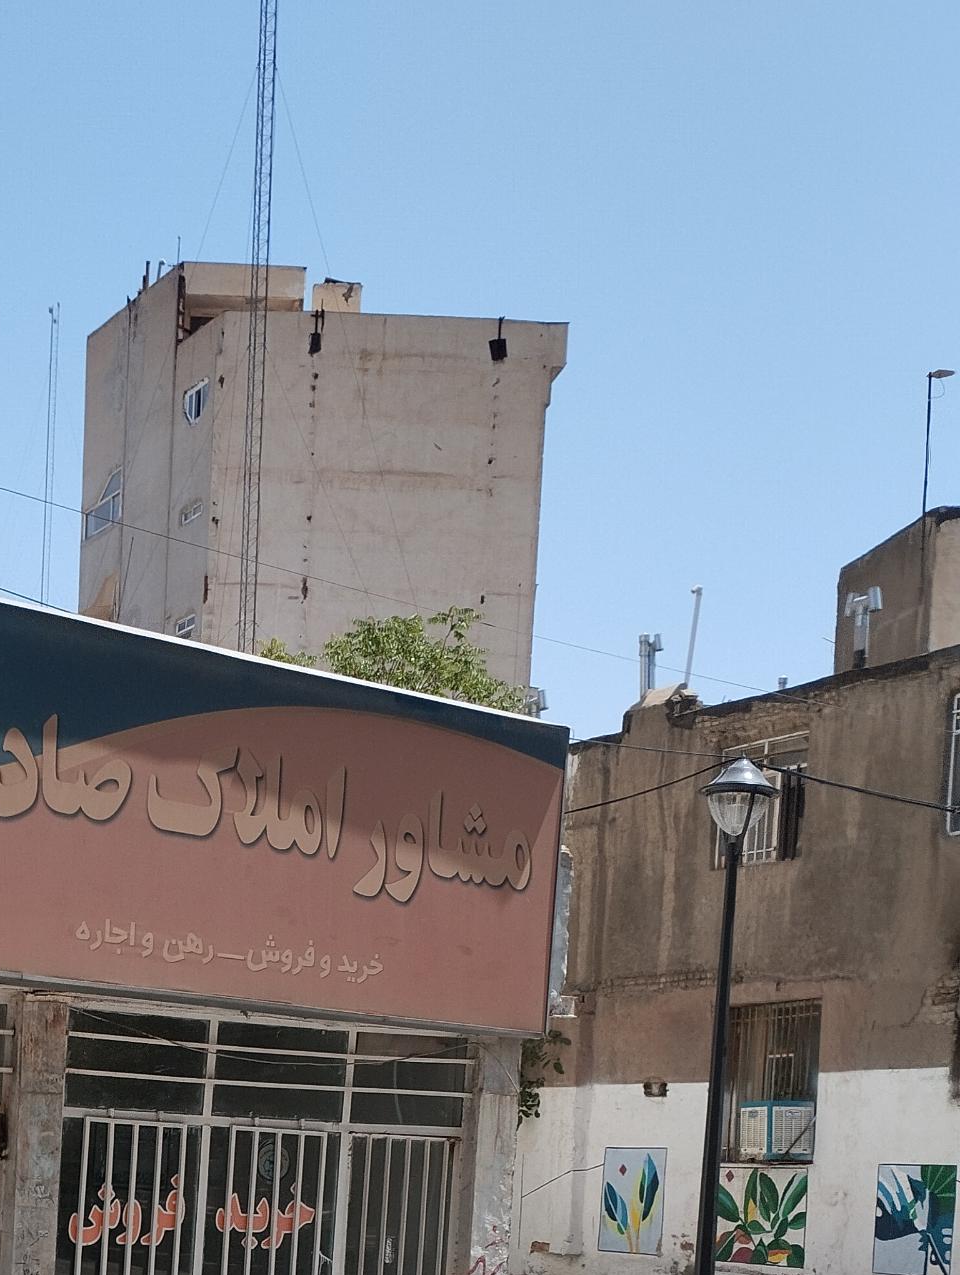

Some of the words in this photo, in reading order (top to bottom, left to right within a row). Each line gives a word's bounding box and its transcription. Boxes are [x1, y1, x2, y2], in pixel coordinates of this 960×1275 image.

[146, 746, 348, 860] املاک
[352, 791, 532, 904] مشاور
[75, 918, 137, 956] اجاره
[142, 931, 155, 958] و
[318, 953, 332, 979] و
[336, 952, 385, 984] خرید
[67, 1173, 186, 1247] فروش
[215, 1181, 317, 1250] خرید
